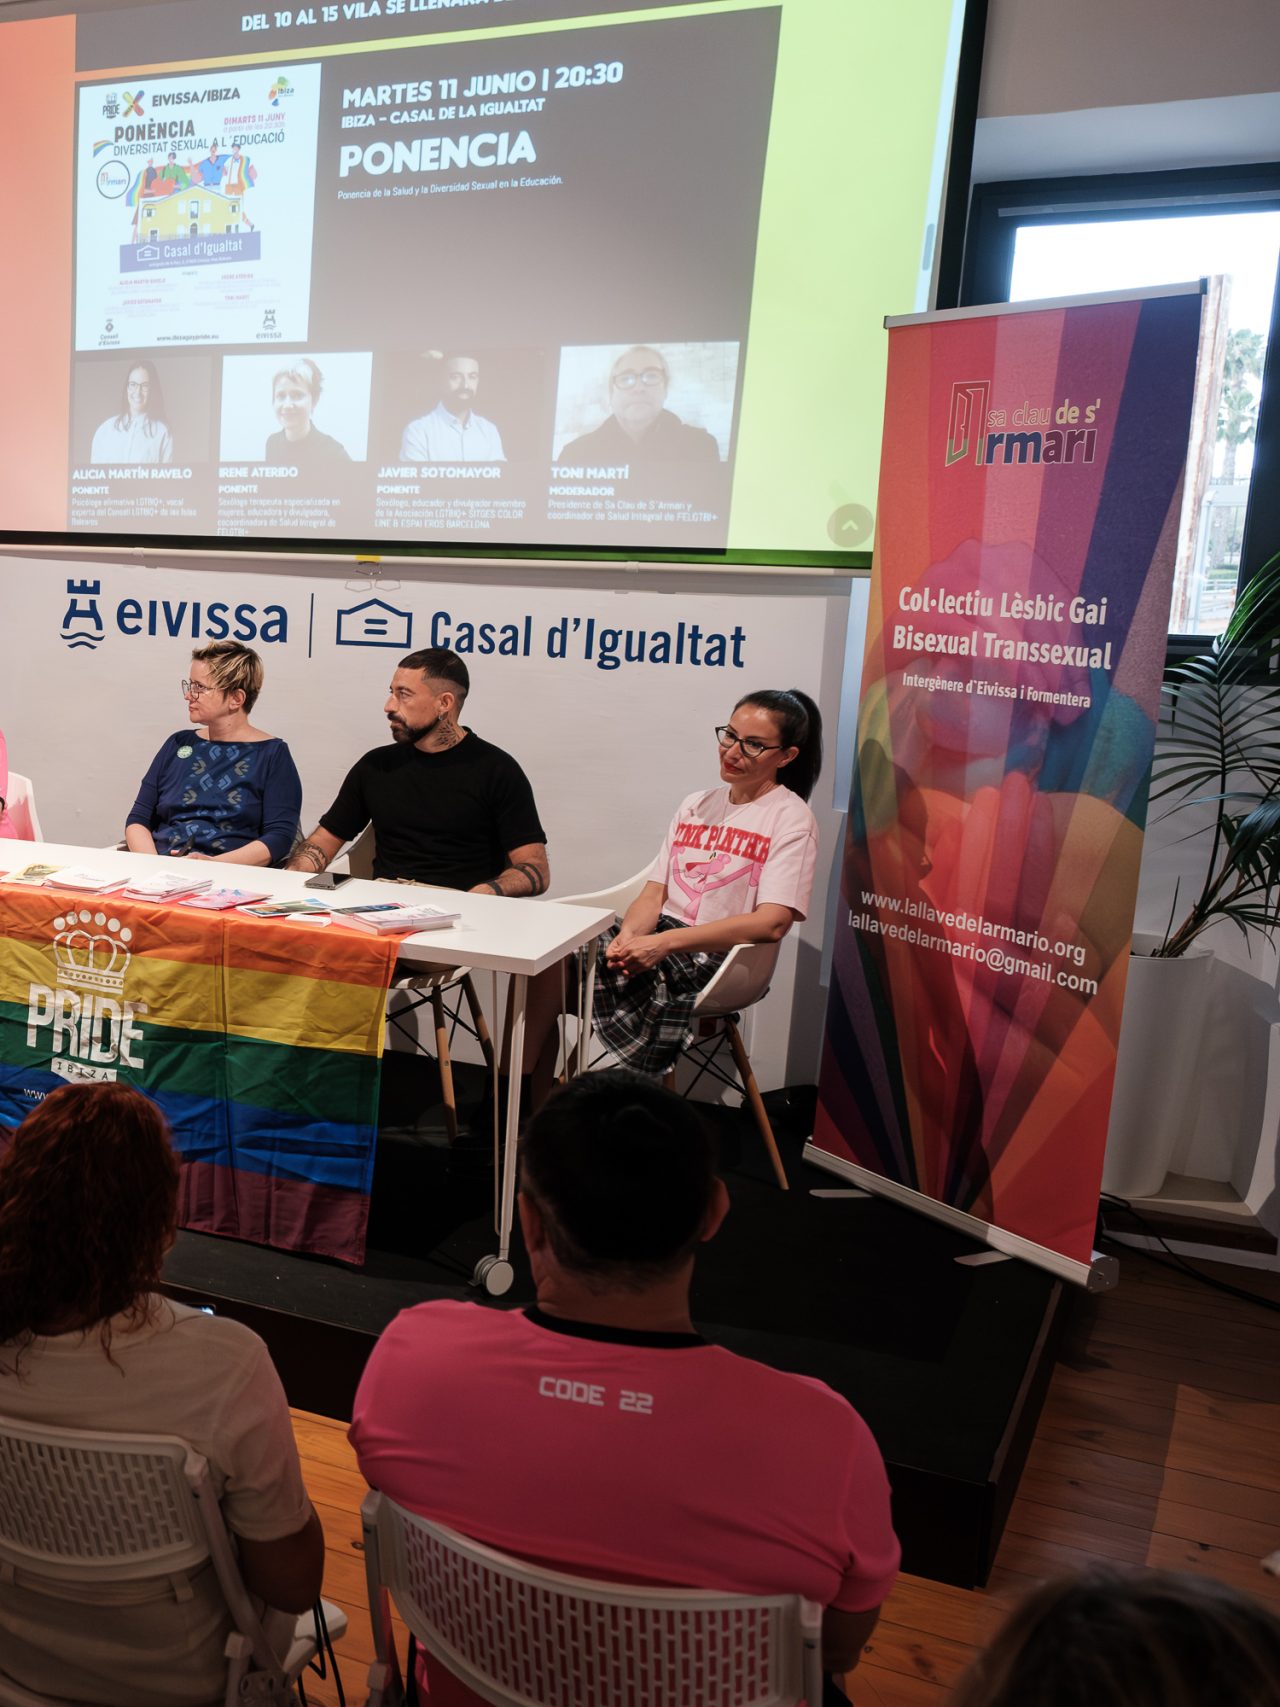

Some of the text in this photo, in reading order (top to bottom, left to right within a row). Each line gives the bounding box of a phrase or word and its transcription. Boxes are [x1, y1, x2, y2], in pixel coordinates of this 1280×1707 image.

[241, 14, 269, 31] DEL
[274, 11, 292, 28] 10
[296, 8, 317, 26] AL
[321, 5, 338, 22] 15
[343, 1, 381, 20] VILA
[386, 0, 406, 14] SE
[342, 80, 433, 109] MARTES
[438, 78, 458, 100] 11
[463, 69, 536, 98] JUNIO
[555, 61, 624, 89] 20:30
[152, 87, 241, 108] EIVISSA/IBIZA
[102, 104, 120, 116] PRIDE
[224, 112, 286, 125] DIMARTS 11 JUNY
[341, 97, 546, 128] IBIZA CASAL DE LA IGUALTAT
[114, 117, 195, 143] PONÈNCIA
[114, 141, 168, 156] DIVERSITAT
[171, 138, 209, 152] SEXUAL
[212, 137, 219, 147] A
[339, 130, 537, 178] PONENCIA
[337, 176, 563, 200] Ponencia de la Salud y la Diversidad Sexual en la Educación.
[164, 244, 191, 258] Casal
[987, 398, 1101, 428] sa clau de s'
[72, 466, 193, 480] ALICIA MARTÍN RAVELO
[219, 466, 298, 478] IRENE ATERIDO
[377, 467, 501, 479] JAVIER SOTOMAYOR
[551, 464, 629, 480] TONI MARTÍ
[72, 486, 109, 494] PONENTE
[218, 484, 258, 494] PONENTE
[376, 485, 421, 494] PONENTE
[549, 485, 615, 497] MODERADOR
[548, 499, 591, 510] Presidente
[593, 500, 603, 510] de
[604, 500, 615, 510] Sa
[637, 500, 647, 510] de
[687, 502, 692, 511] y
[607, 511, 629, 520] Salud
[1000, 591, 1065, 622] Lèsbic
[1069, 596, 1108, 625] Gai
[116, 598, 288, 644] eivissa
[430, 611, 532, 657] Casal
[893, 624, 1112, 670] Bisexual Transsexual
[902, 672, 963, 694] Intergènere
[1020, 684, 1025, 700] i
[1027, 686, 1091, 709] Formentera
[861, 890, 1087, 967] www.lallavedelarmario.org
[848, 909, 1098, 996] lallavedelarmario@gmail.com
[27, 982, 148, 1069] PRIDE
[56, 1061, 110, 1081] IBIZA
[539, 1376, 653, 1415] CODE 22
